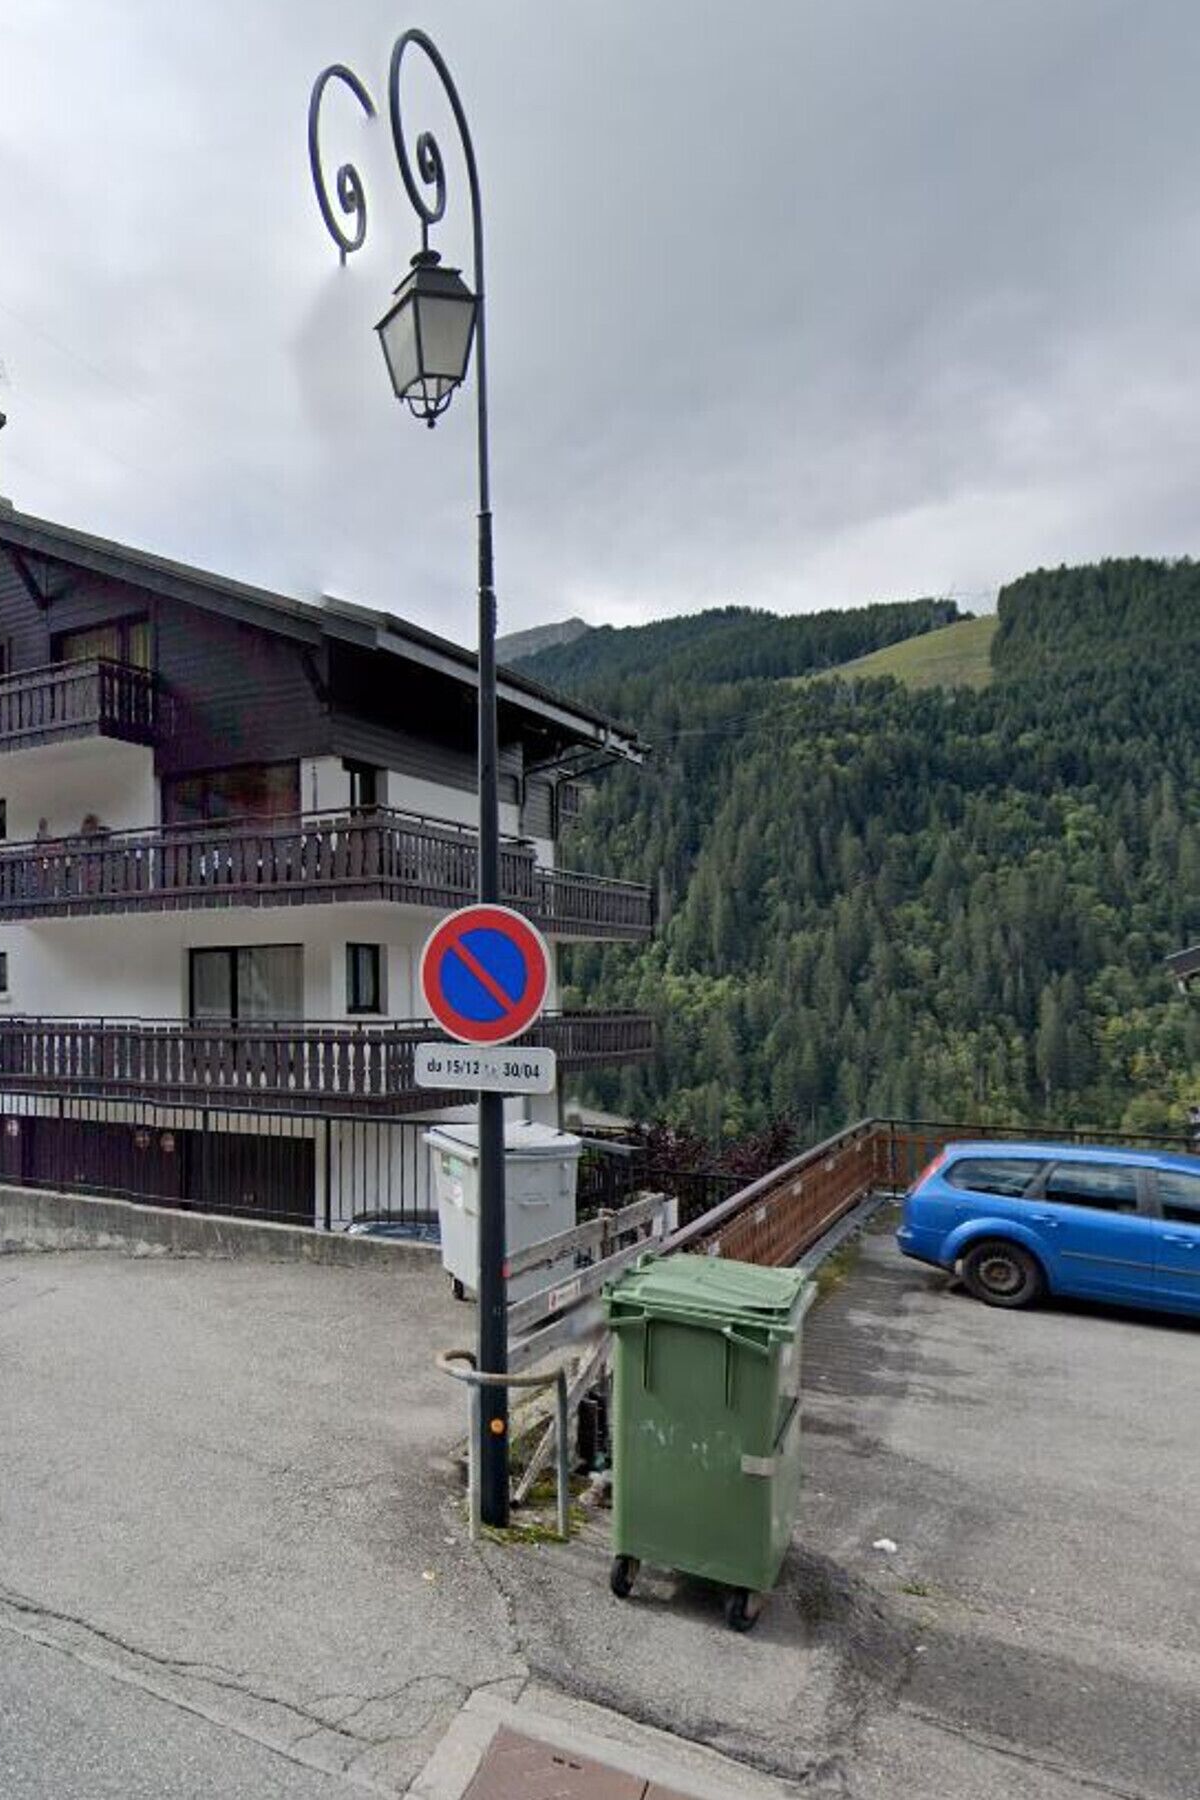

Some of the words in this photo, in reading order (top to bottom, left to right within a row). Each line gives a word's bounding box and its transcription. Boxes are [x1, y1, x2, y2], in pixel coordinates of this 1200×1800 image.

[427, 1058, 442, 1073] du
[446, 1059, 480, 1075] 15/12
[503, 1062, 540, 1079] 30/04
